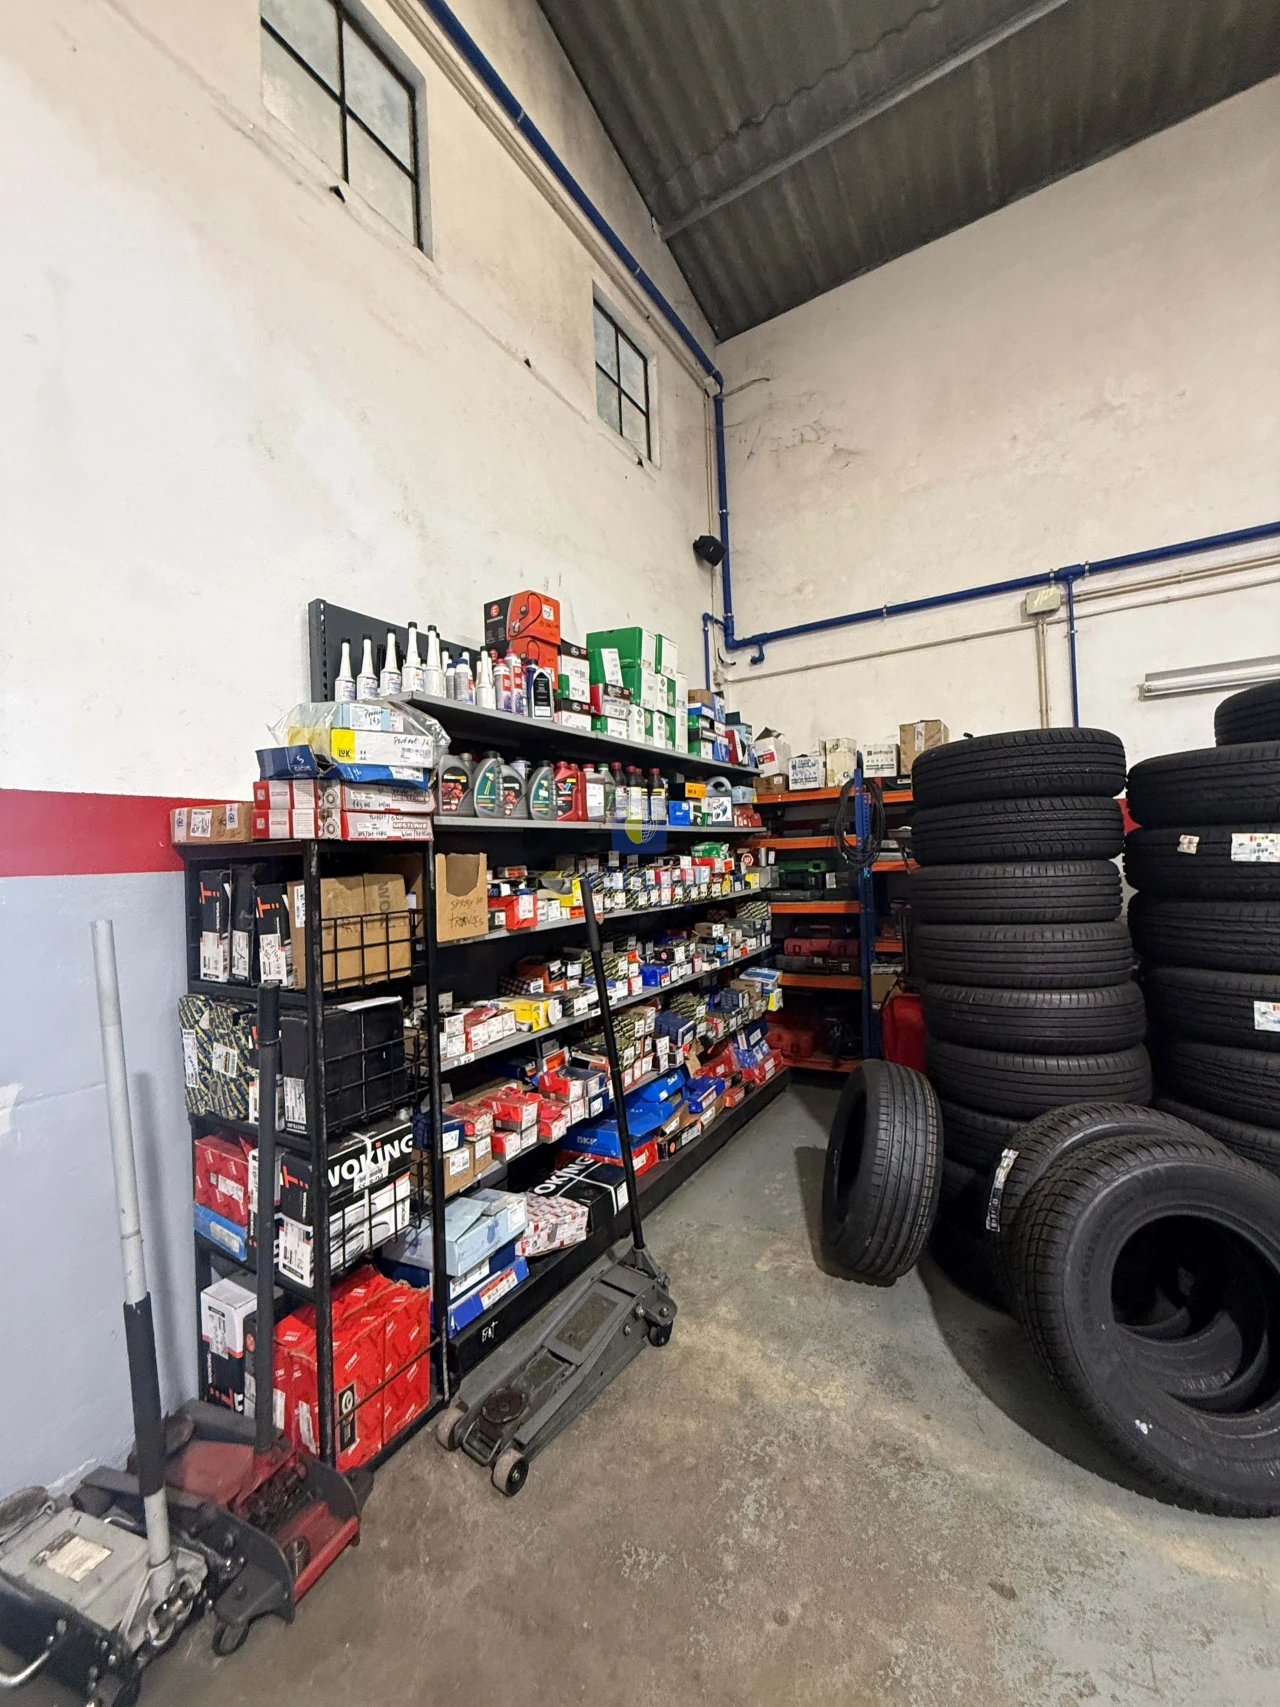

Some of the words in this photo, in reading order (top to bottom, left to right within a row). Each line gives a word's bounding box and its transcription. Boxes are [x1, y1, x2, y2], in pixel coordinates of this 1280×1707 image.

[393, 821, 428, 830] WESTLAKE
[576, 1136, 598, 1145] SKF
[533, 1156, 595, 1194] OKING
